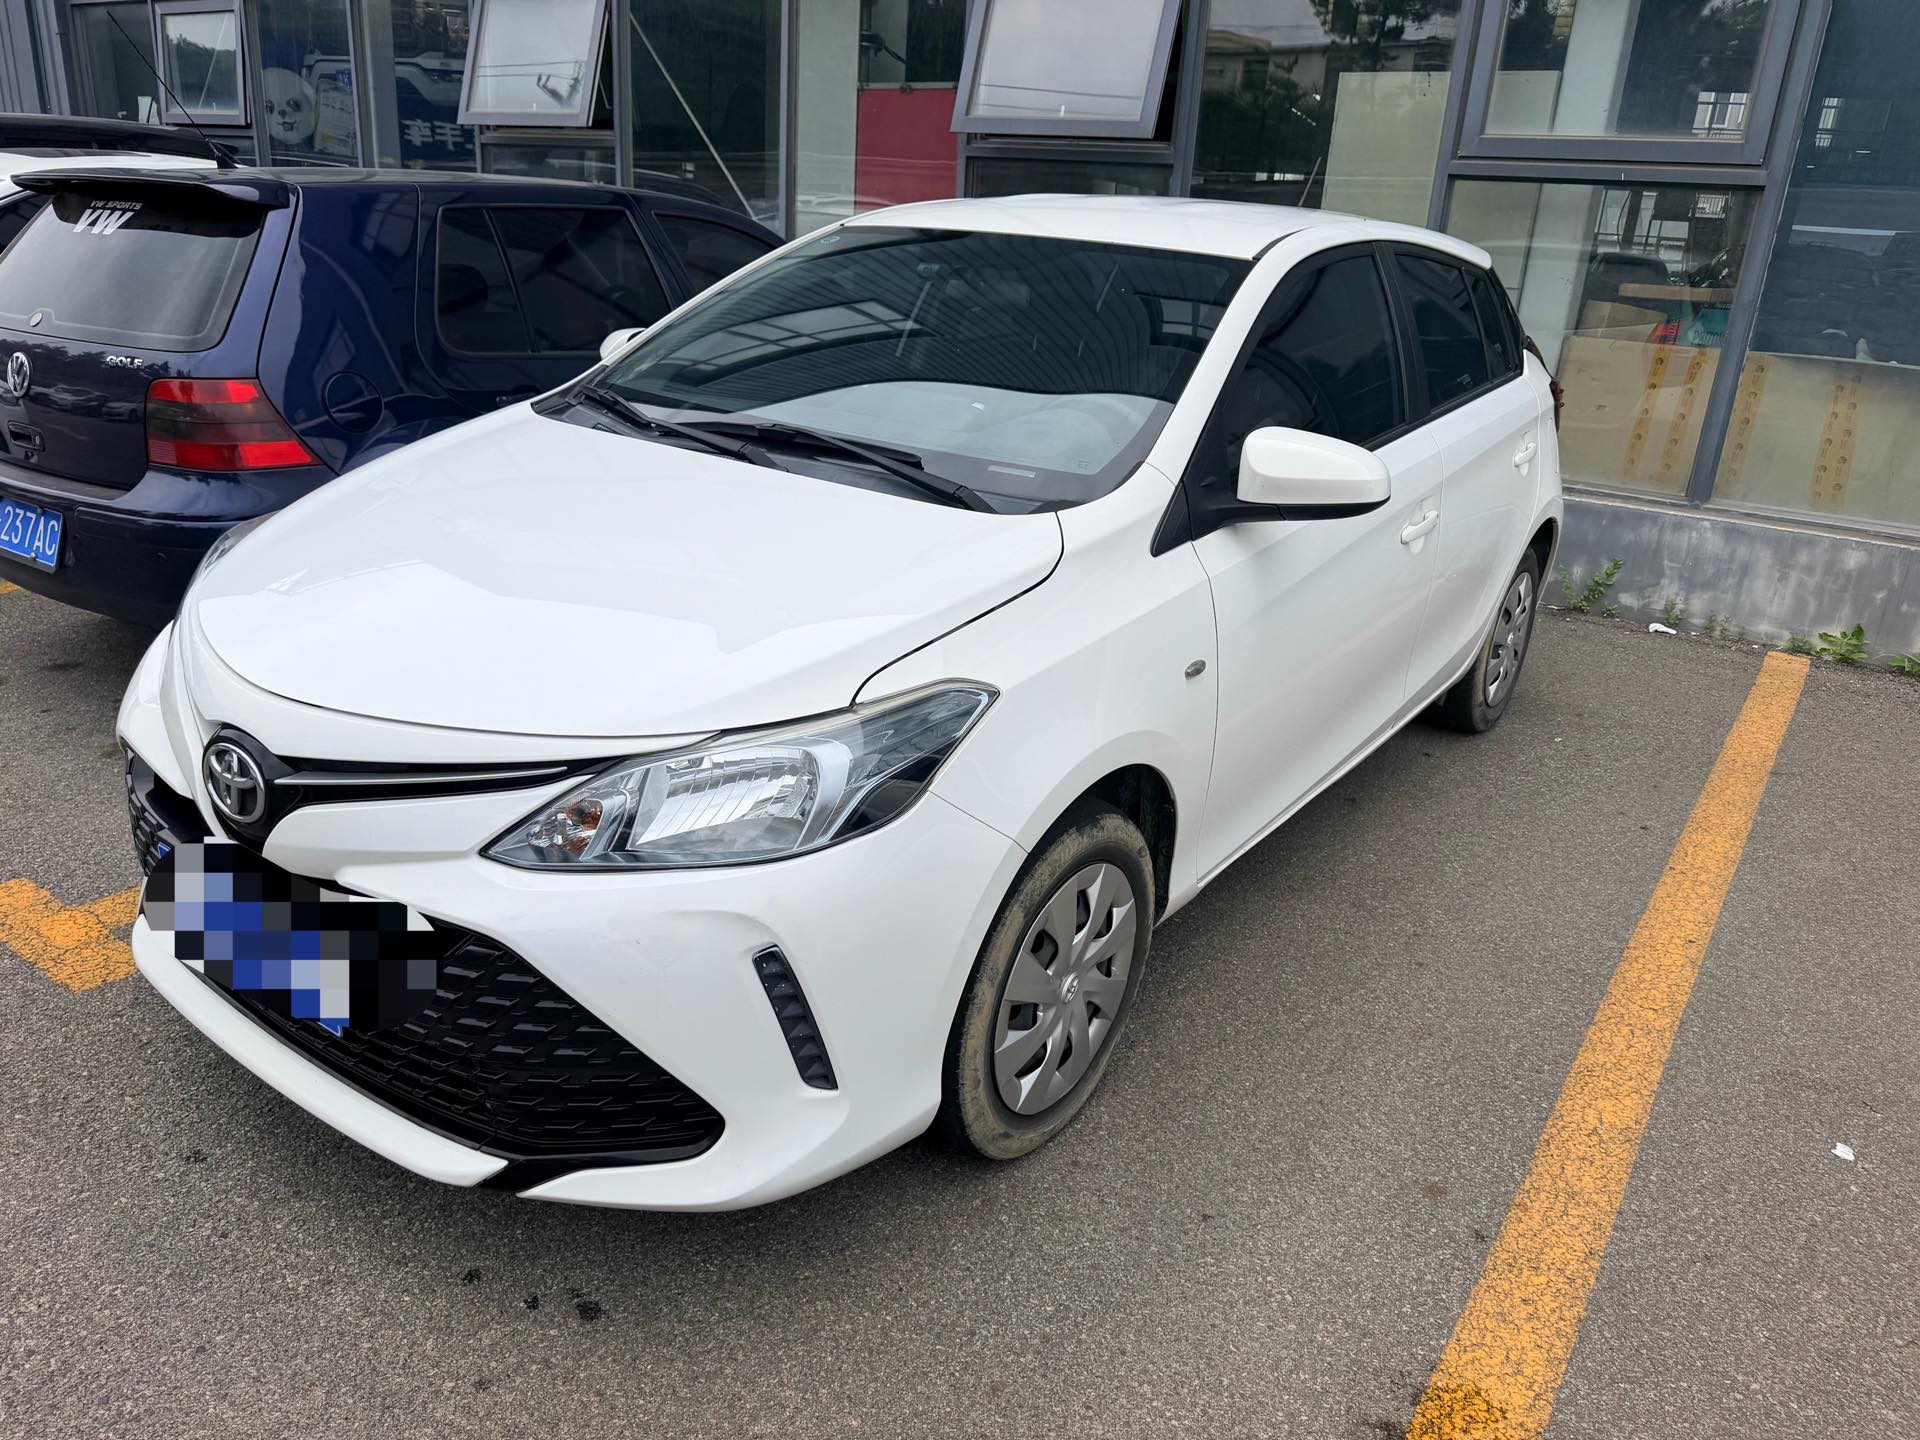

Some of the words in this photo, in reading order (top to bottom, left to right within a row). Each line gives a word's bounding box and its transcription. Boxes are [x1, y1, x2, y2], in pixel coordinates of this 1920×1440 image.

[90, 200, 106, 208] VW
[105, 201, 143, 210] SPORTS
[73, 208, 135, 235] VW
[106, 355, 144, 369] GOLF
